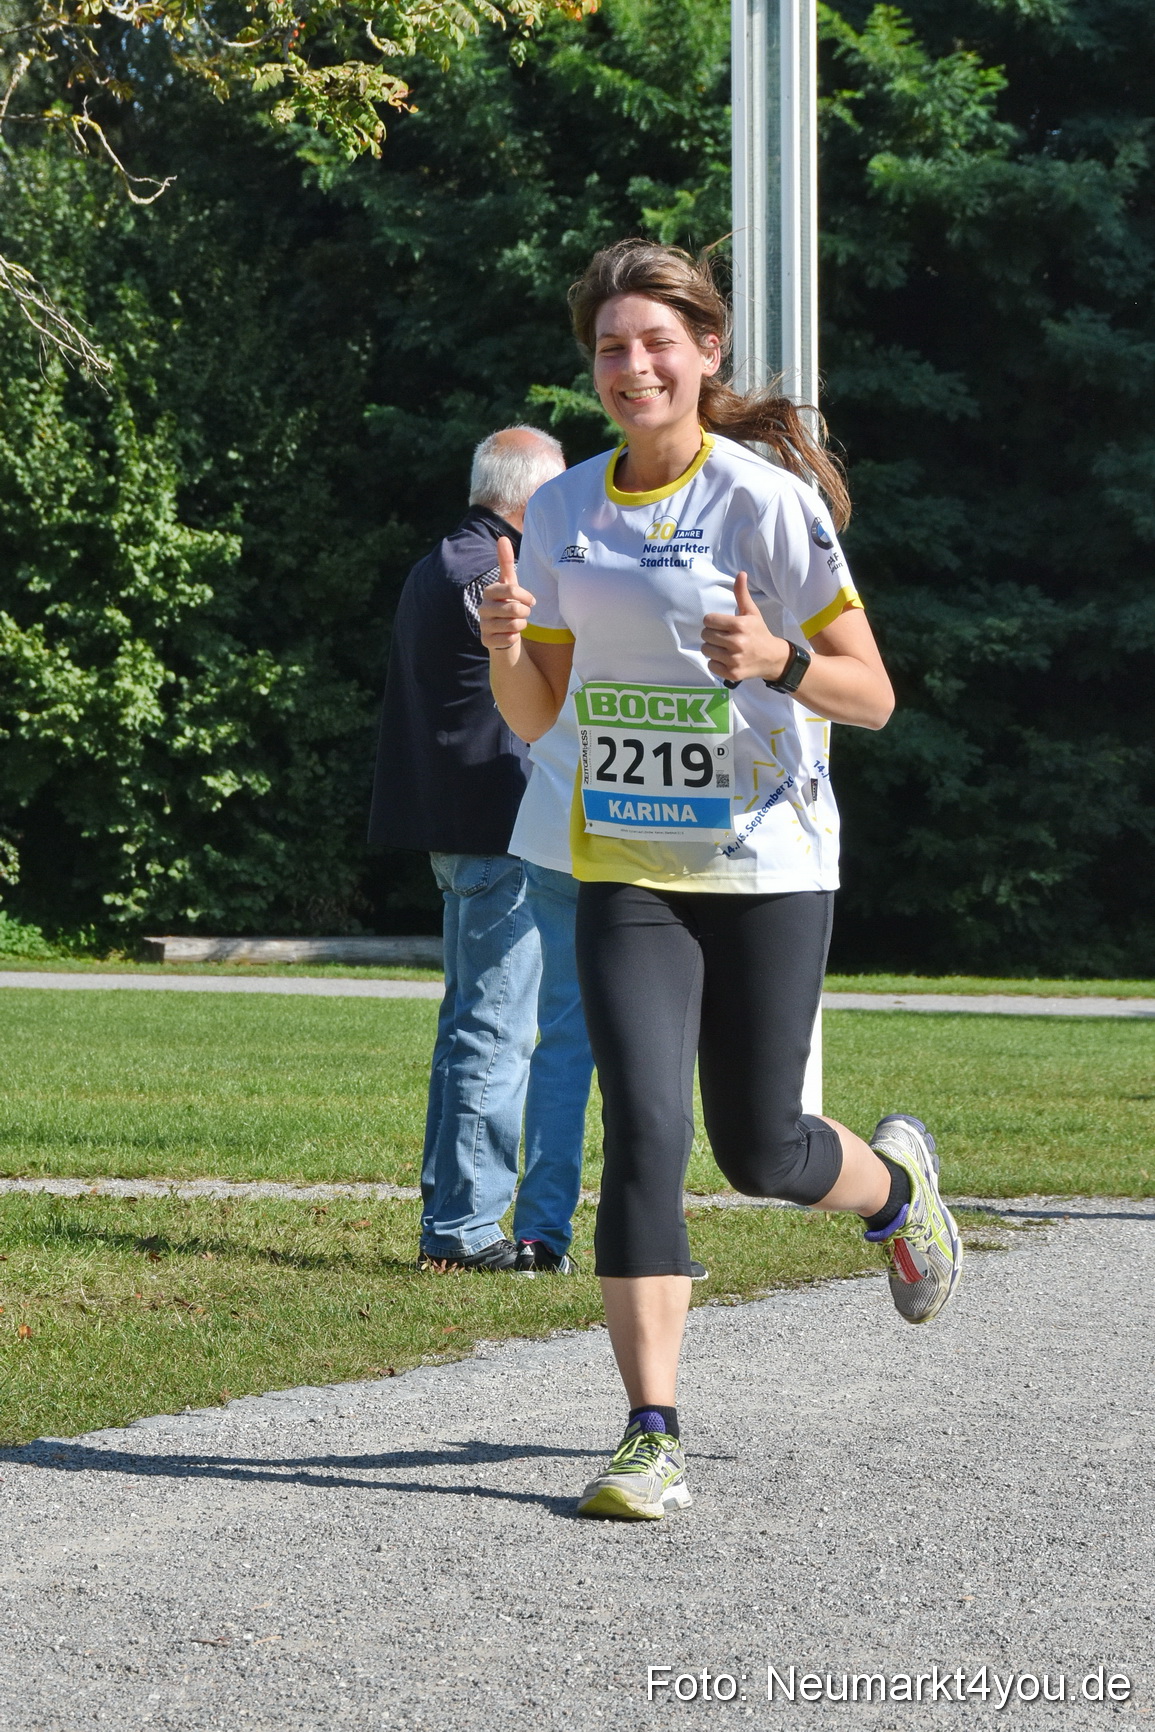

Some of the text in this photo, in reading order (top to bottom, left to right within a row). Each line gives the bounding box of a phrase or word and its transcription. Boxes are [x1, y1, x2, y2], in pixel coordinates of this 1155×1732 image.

[646, 522, 702, 540] 20 JAHRE
[642, 542, 711, 554] Neumarkter
[639, 556, 695, 570] Stadtlauf
[586, 688, 717, 728] BOCK
[596, 736, 714, 788] 2219
[716, 747, 726, 756] D
[608, 799, 698, 823] KARINA
[745, 784, 786, 834] September
